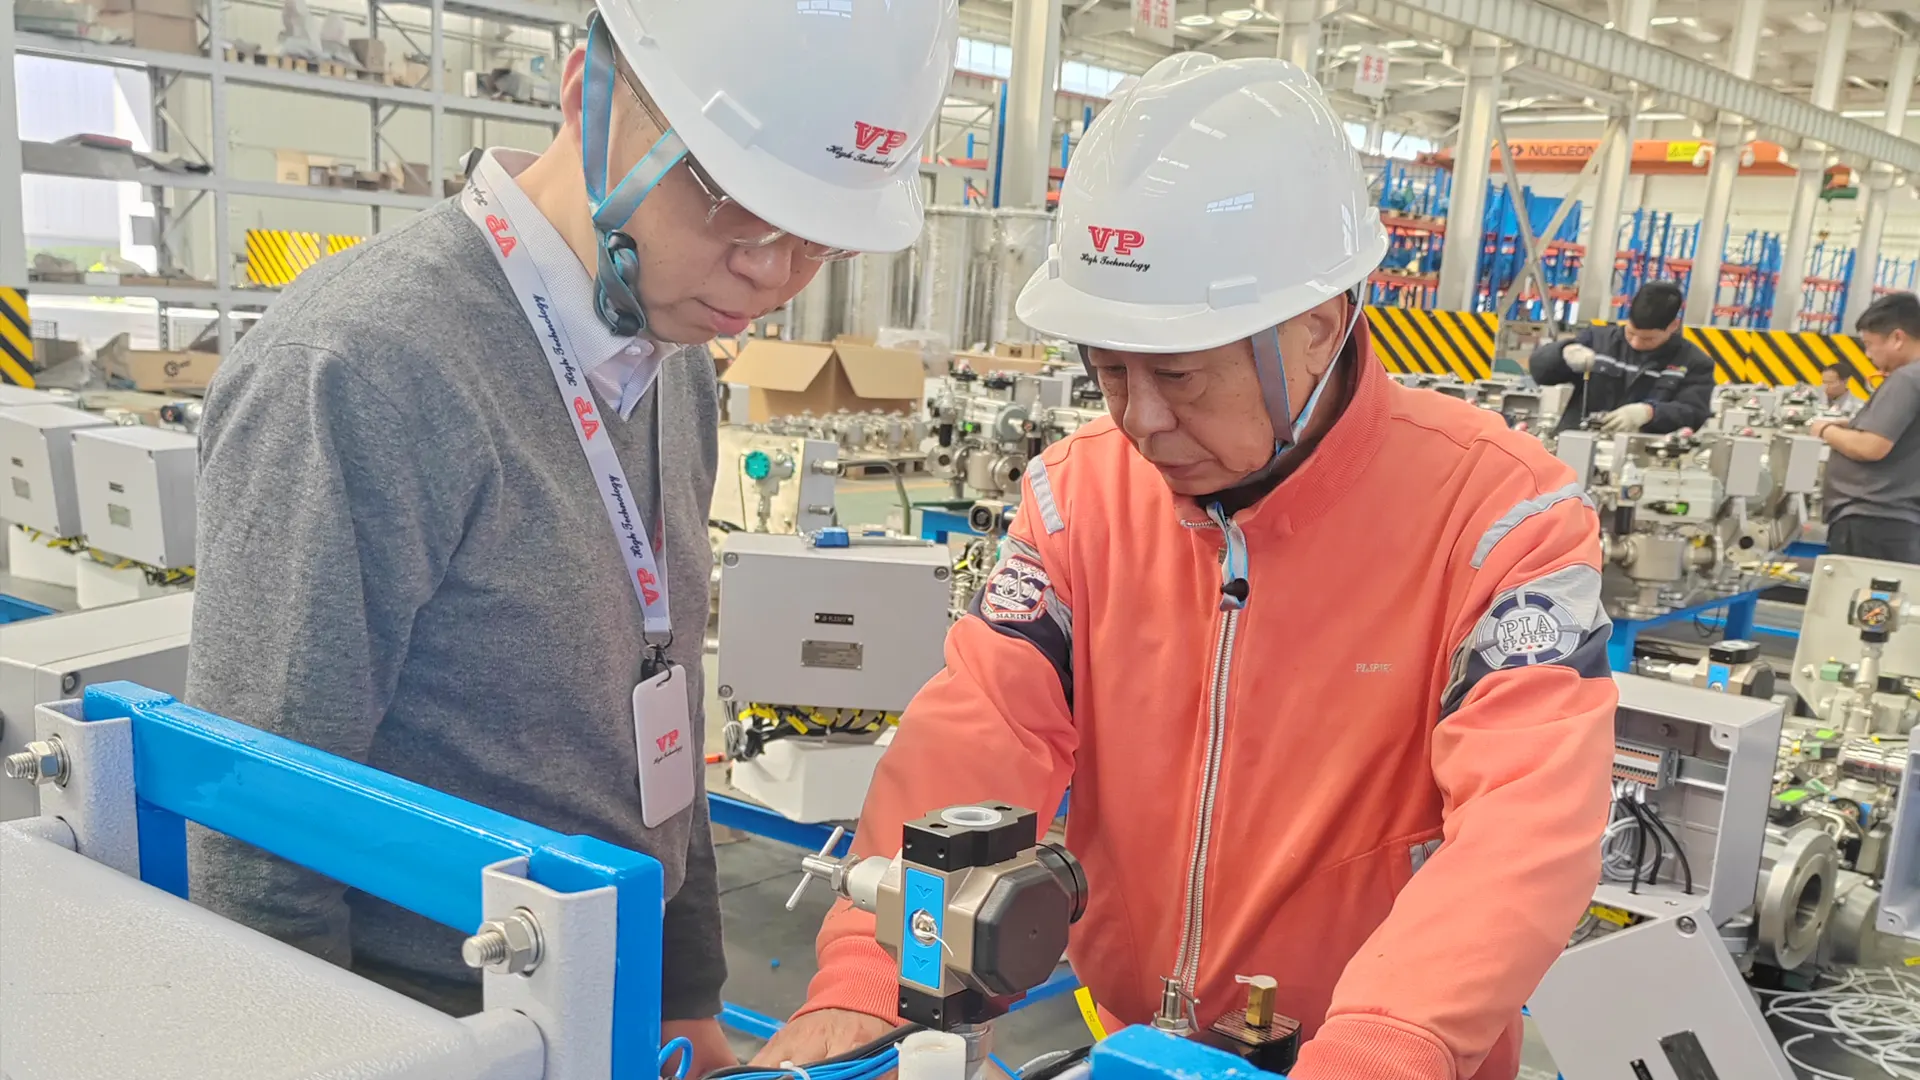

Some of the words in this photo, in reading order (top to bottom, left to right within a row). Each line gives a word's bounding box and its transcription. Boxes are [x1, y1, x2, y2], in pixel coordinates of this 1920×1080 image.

[854, 121, 907, 155] VP
[485, 214, 517, 258] VP
[1088, 225, 1145, 256] VP
[1080, 253, 1098, 266] High
[1100, 256, 1151, 272] Technology
[533, 293, 565, 356] Technology
[559, 357, 578, 387] High
[574, 396, 600, 441] VP
[608, 473, 634, 531] Technology
[625, 531, 644, 559] High
[637, 567, 660, 607] VP
[1500, 614, 1555, 643] PIA
[1502, 632, 1557, 652] SPORTS
[656, 729, 680, 752] VP
